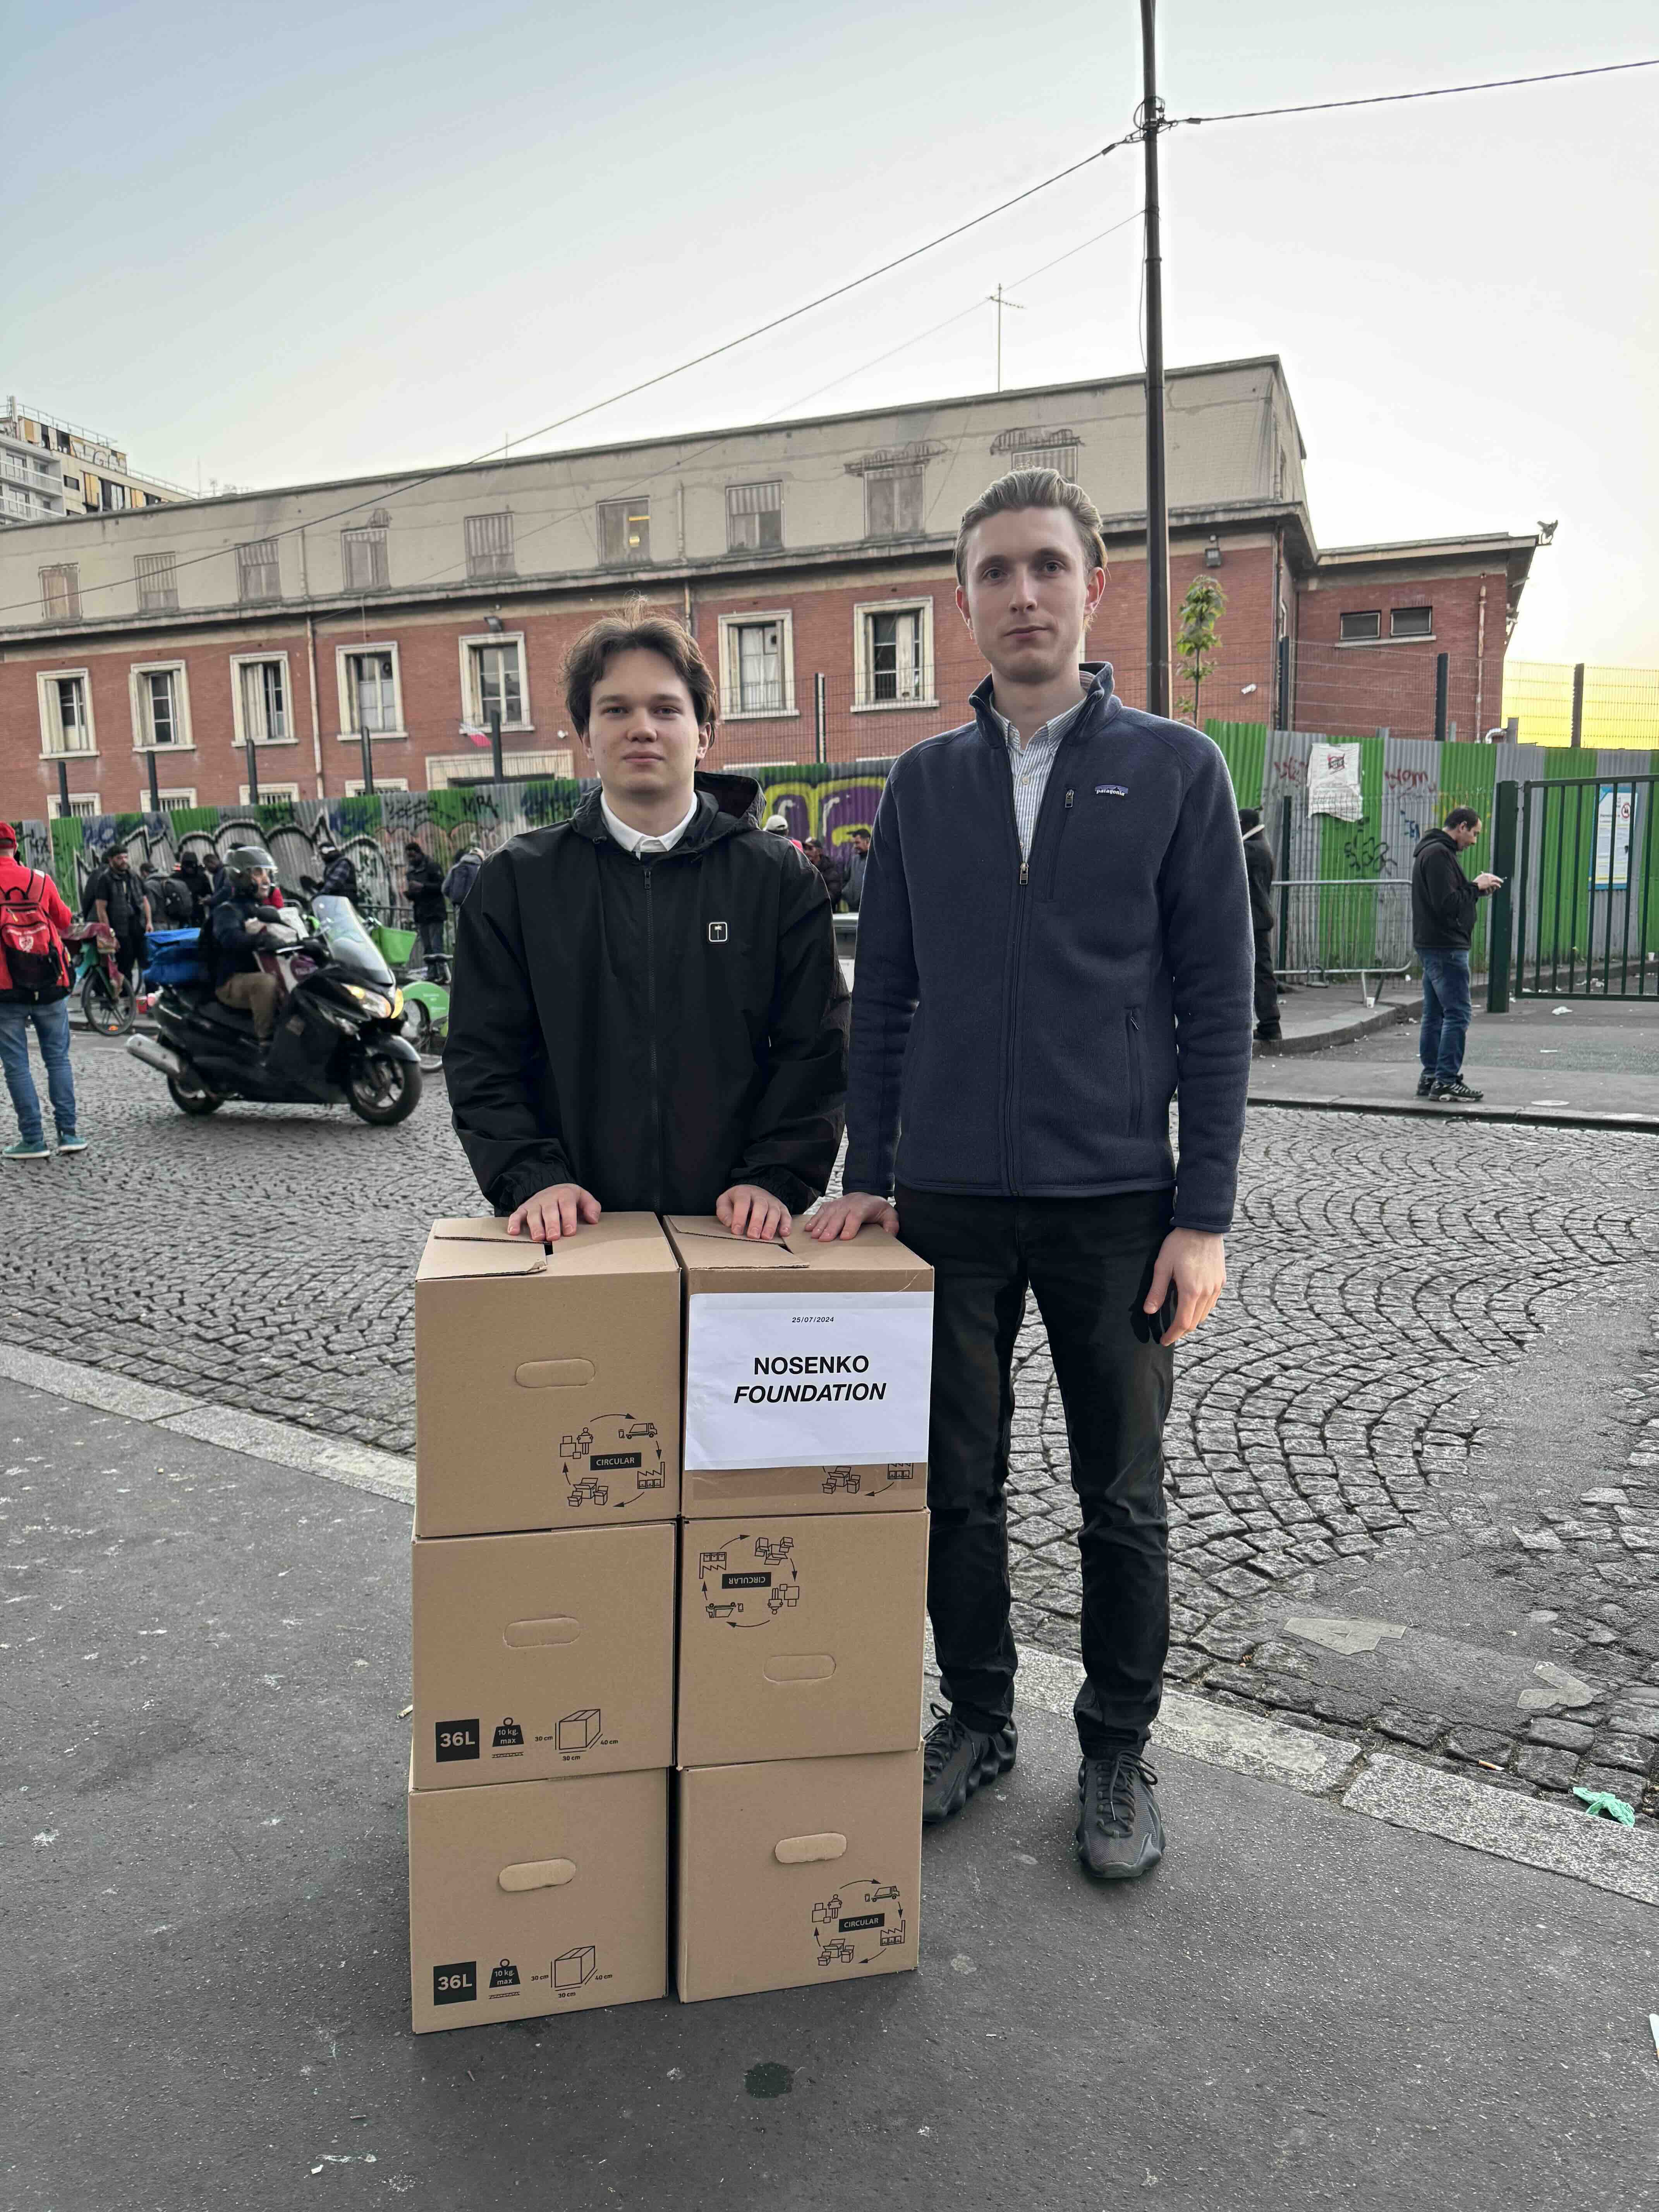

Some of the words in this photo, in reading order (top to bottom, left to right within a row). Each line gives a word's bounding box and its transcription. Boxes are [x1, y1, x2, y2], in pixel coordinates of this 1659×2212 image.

[754, 1355, 869, 1375] NOSENKO
[733, 1382, 887, 1404] FOUNDATION
[596, 1457, 635, 1466] CIRCULAR
[440, 1731, 476, 1748] 36L
[844, 1918, 879, 1927] CIRCULAR
[437, 1973, 472, 1991] 36L
